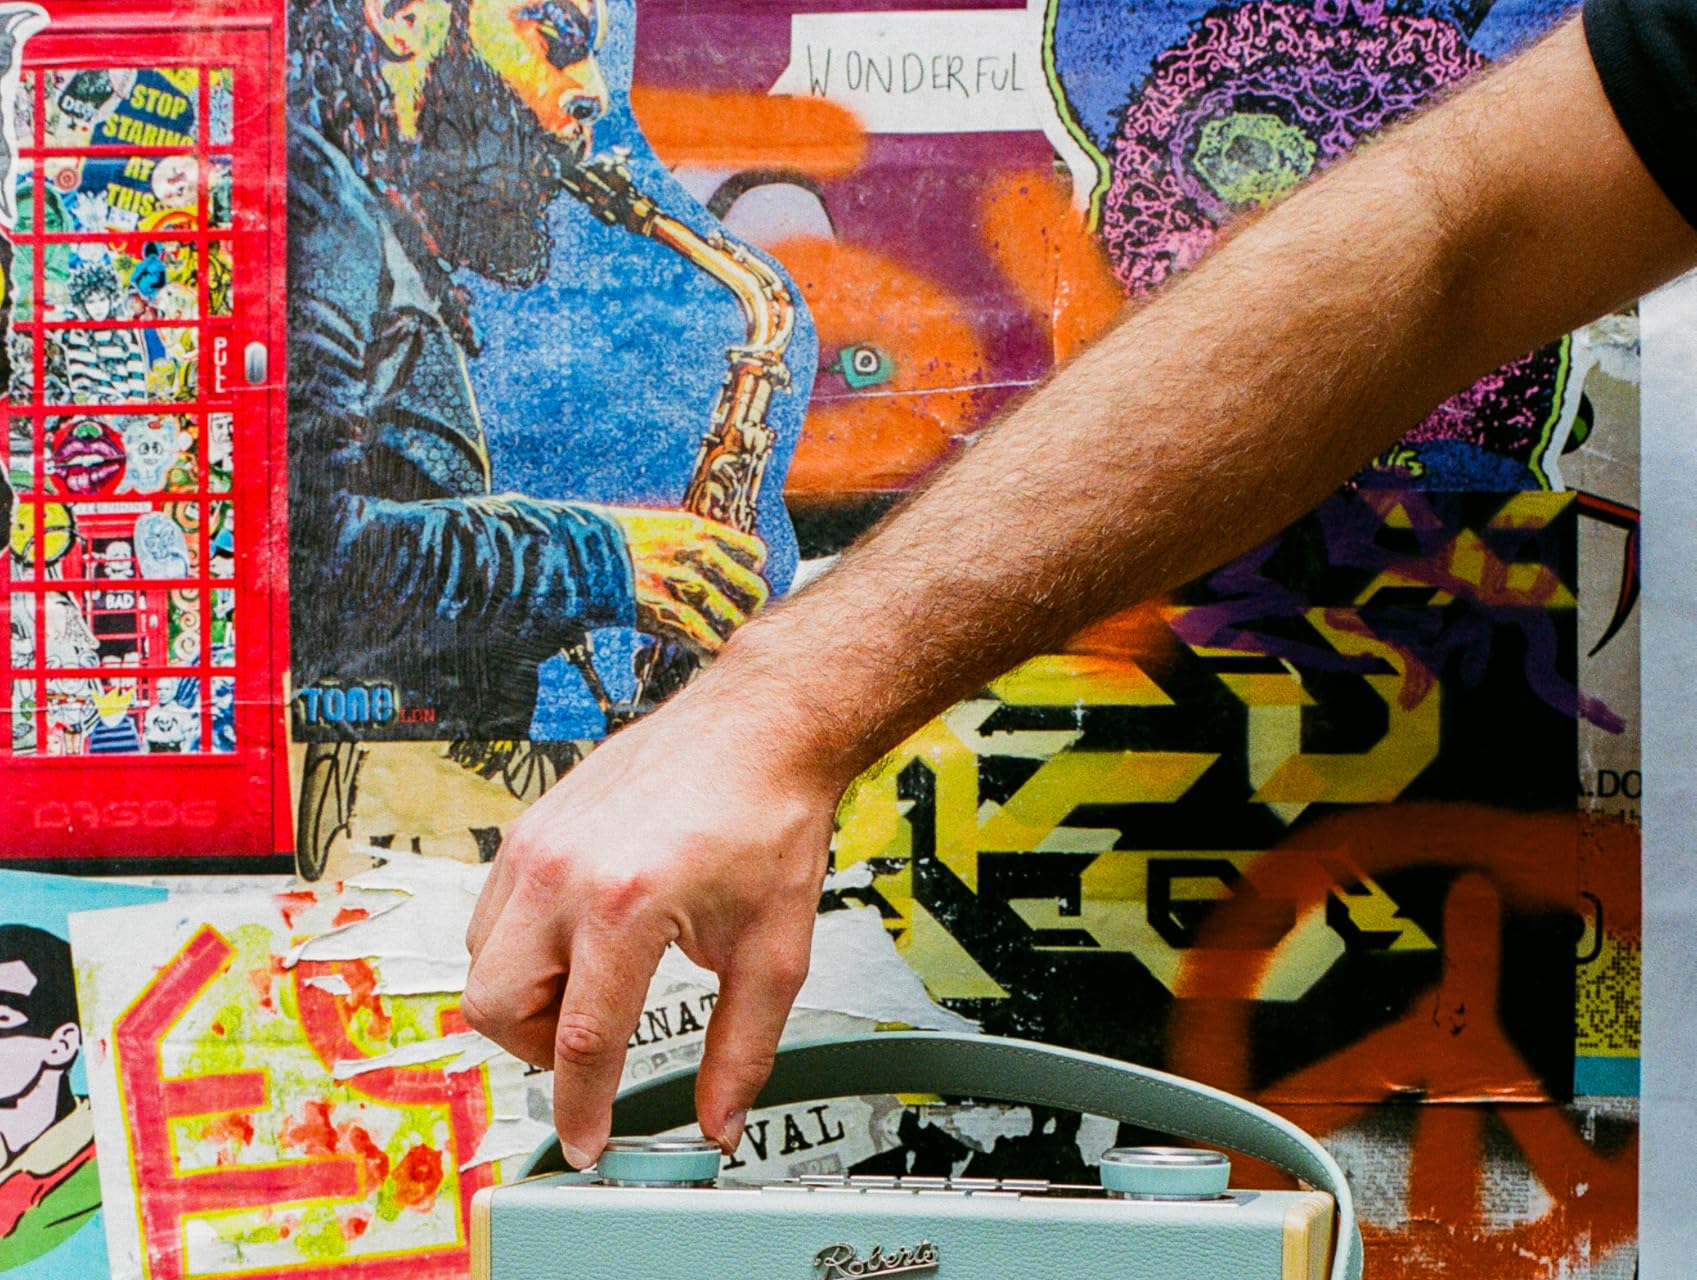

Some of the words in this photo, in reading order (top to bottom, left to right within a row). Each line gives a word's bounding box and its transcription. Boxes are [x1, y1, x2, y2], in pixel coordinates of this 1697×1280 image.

[130, 84, 187, 119] STOP
[124, 157, 154, 180] AT
[106, 183, 155, 214] THIS
[213, 336, 229, 394] PULL
[105, 591, 136, 610] BAD
